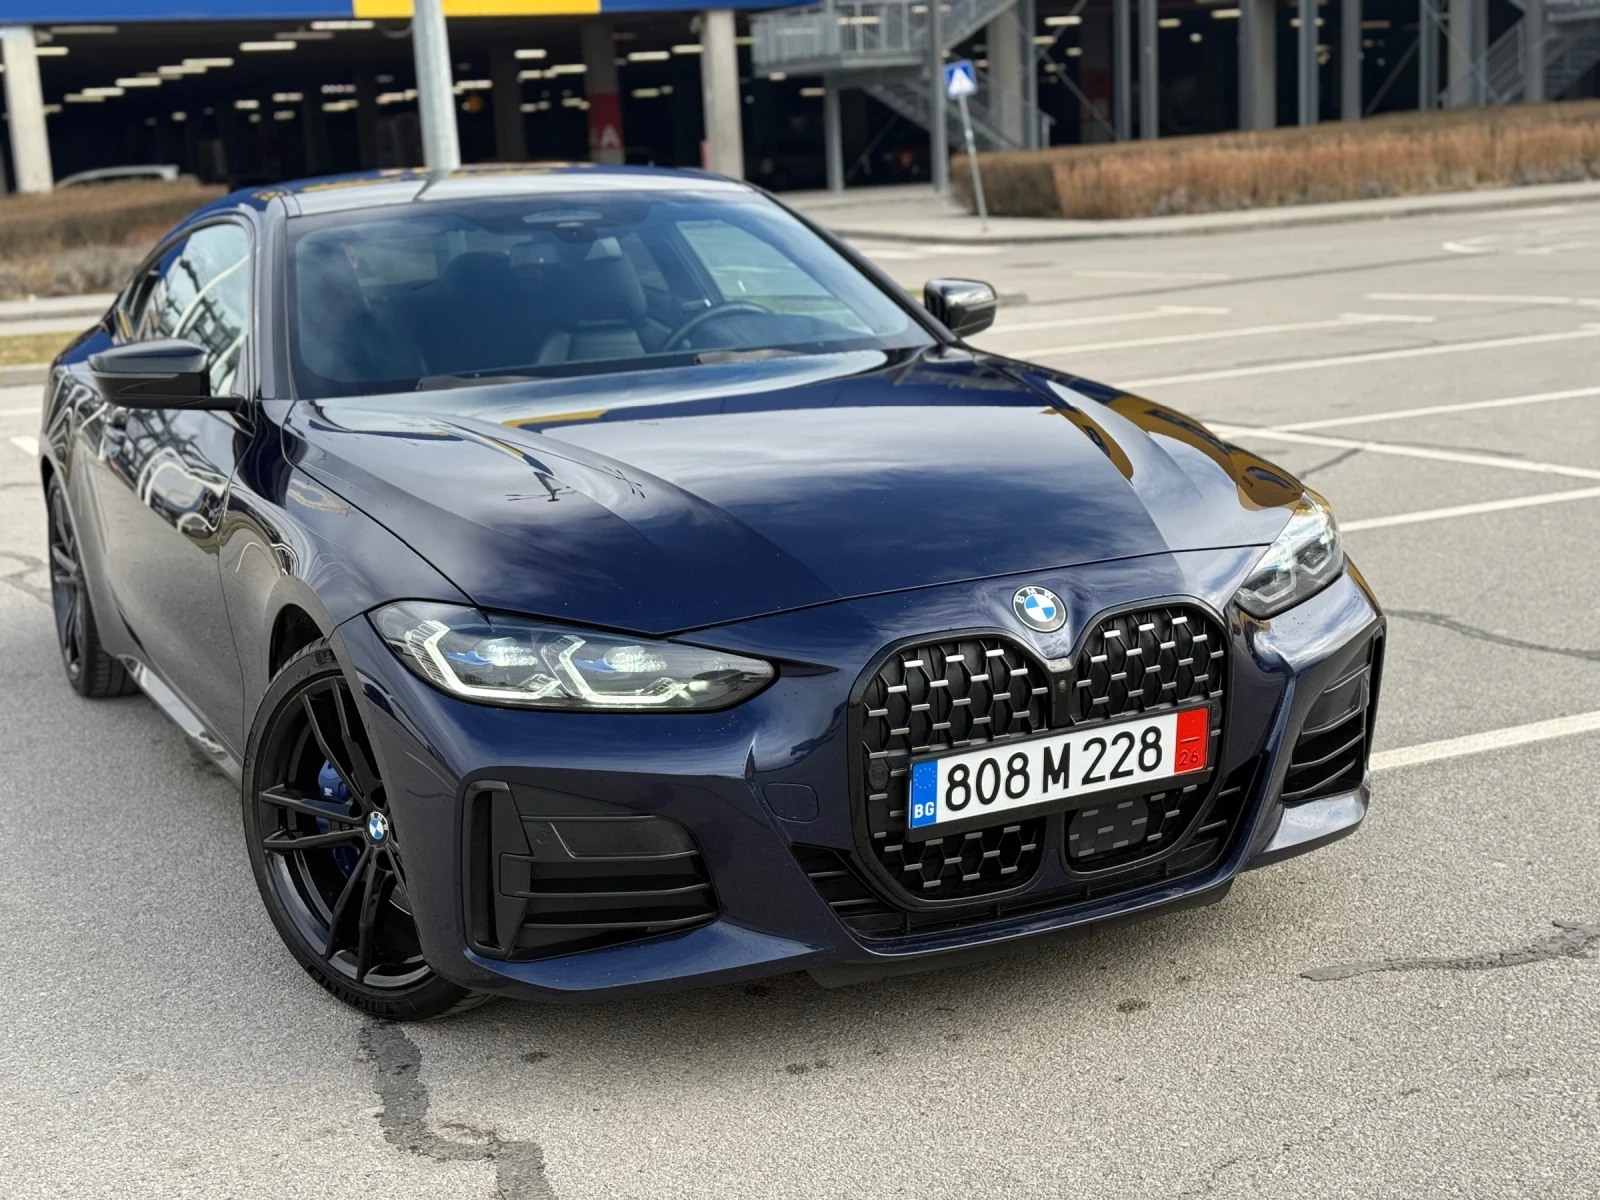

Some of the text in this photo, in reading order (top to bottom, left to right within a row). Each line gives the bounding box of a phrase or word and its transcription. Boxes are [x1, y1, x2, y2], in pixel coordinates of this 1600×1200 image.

[1015, 587, 1055, 603] BMW
[1179, 748, 1199, 767] 26
[945, 725, 1163, 812] 808 M 228
[914, 801, 935, 819] BG
[370, 811, 389, 831] BMW
[309, 965, 388, 1013] MICHELIN
